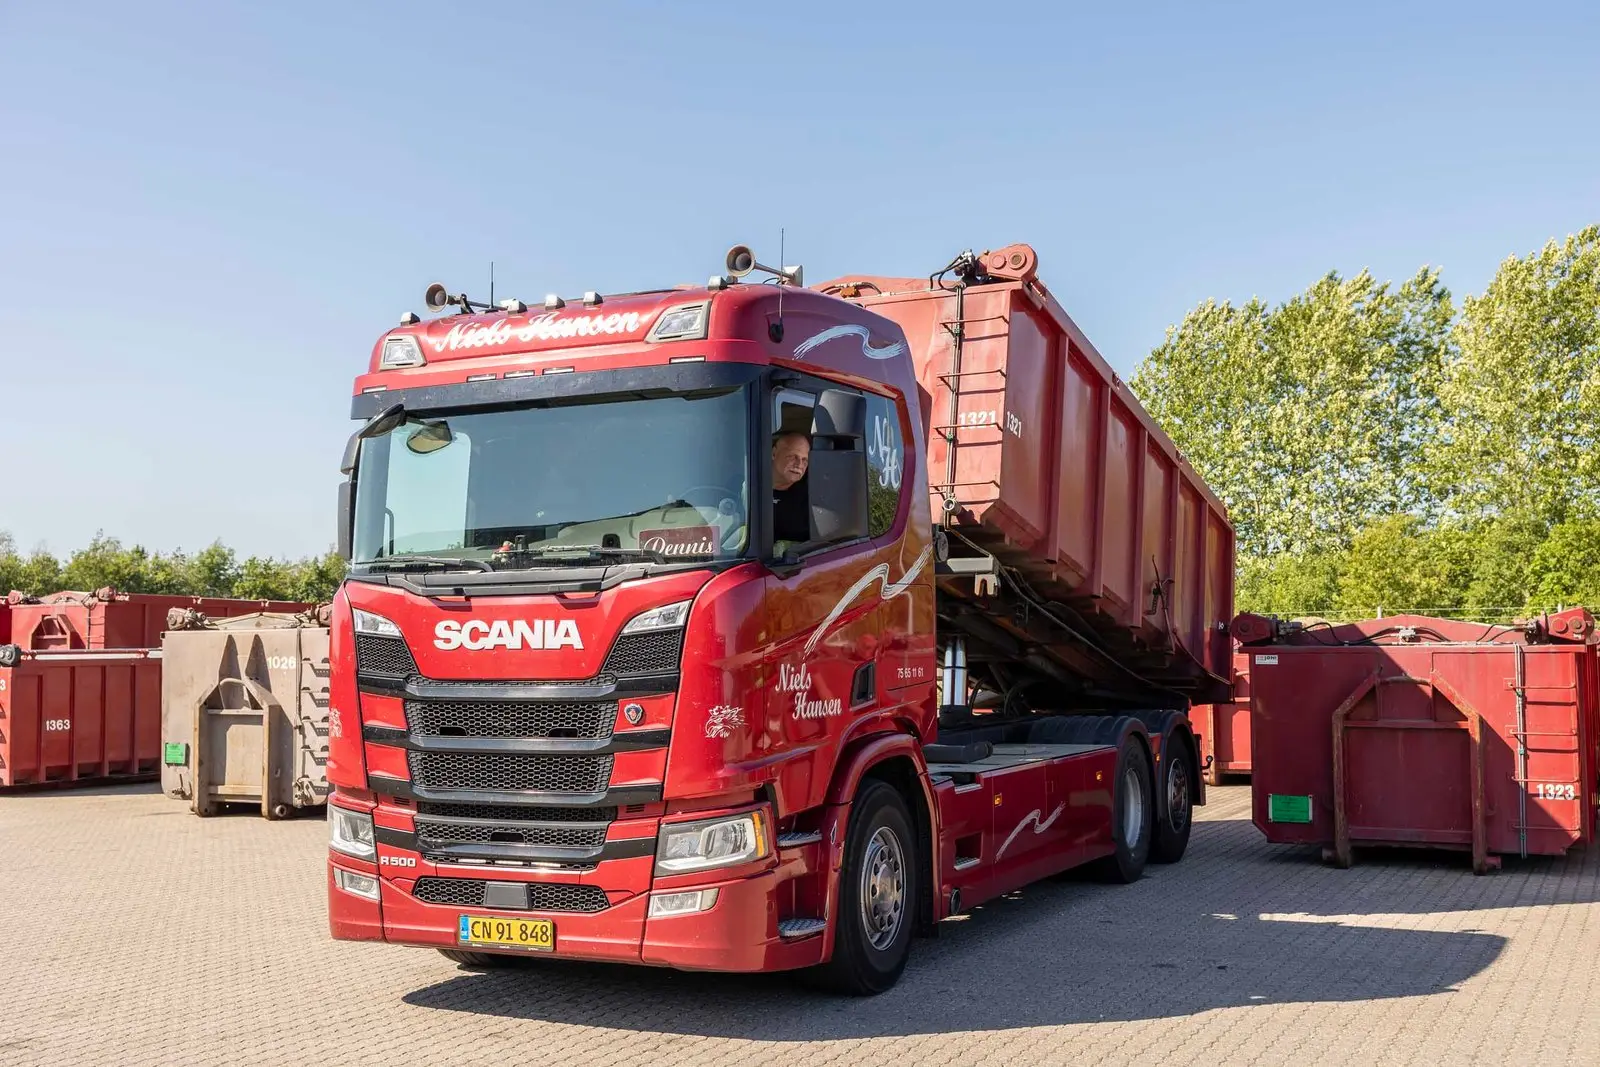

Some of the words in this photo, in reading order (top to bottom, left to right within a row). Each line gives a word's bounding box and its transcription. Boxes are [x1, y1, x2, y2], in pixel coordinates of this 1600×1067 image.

[435, 318, 511, 351] Niels
[519, 310, 641, 342] Hansen
[958, 411, 997, 430] 1321
[1006, 411, 1023, 438] 1321
[643, 536, 714, 556] Dennis
[433, 619, 584, 650] SCANIA
[266, 656, 297, 669] 1026
[896, 668, 904, 679] 75
[904, 667, 912, 678] 65
[912, 667, 917, 678] 11
[917, 667, 924, 678] 61
[775, 662, 812, 692] Niels
[792, 691, 842, 720] Hansen
[46, 719, 71, 731] 1363
[1536, 783, 1575, 800] 1323
[471, 920, 492, 939] CN
[496, 922, 513, 941] 91
[519, 923, 549, 943] 848
